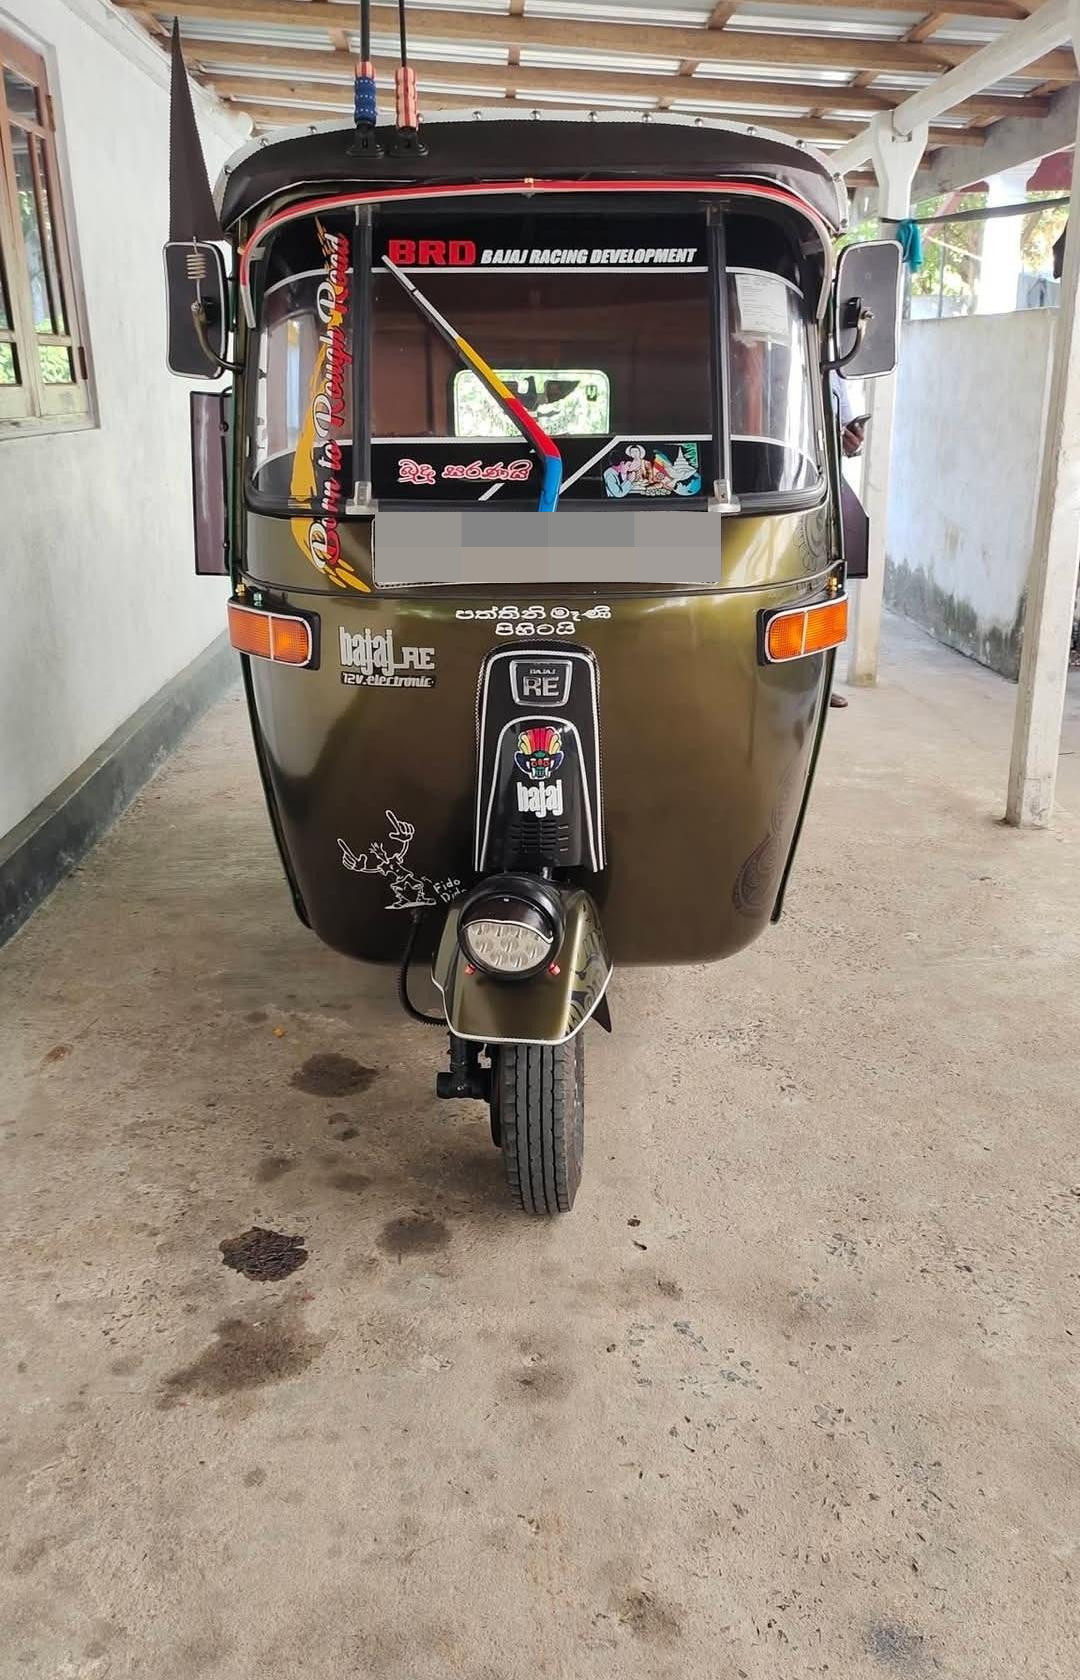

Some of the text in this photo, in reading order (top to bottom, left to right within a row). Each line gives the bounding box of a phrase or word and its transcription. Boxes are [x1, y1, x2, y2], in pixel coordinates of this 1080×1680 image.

[388, 239, 697, 265] BRD BAJAJ RACING DEVELOPMENT
[309, 232, 353, 569] Born to Rough Road
[398, 459, 533, 484] බුදු සරණයි
[455, 605, 546, 620] පත්තිනි
[495, 621, 576, 636] පිහිටයි
[522, 676, 560, 697] RE
[516, 779, 564, 818] bajaj
[432, 876, 461, 894] Fido
